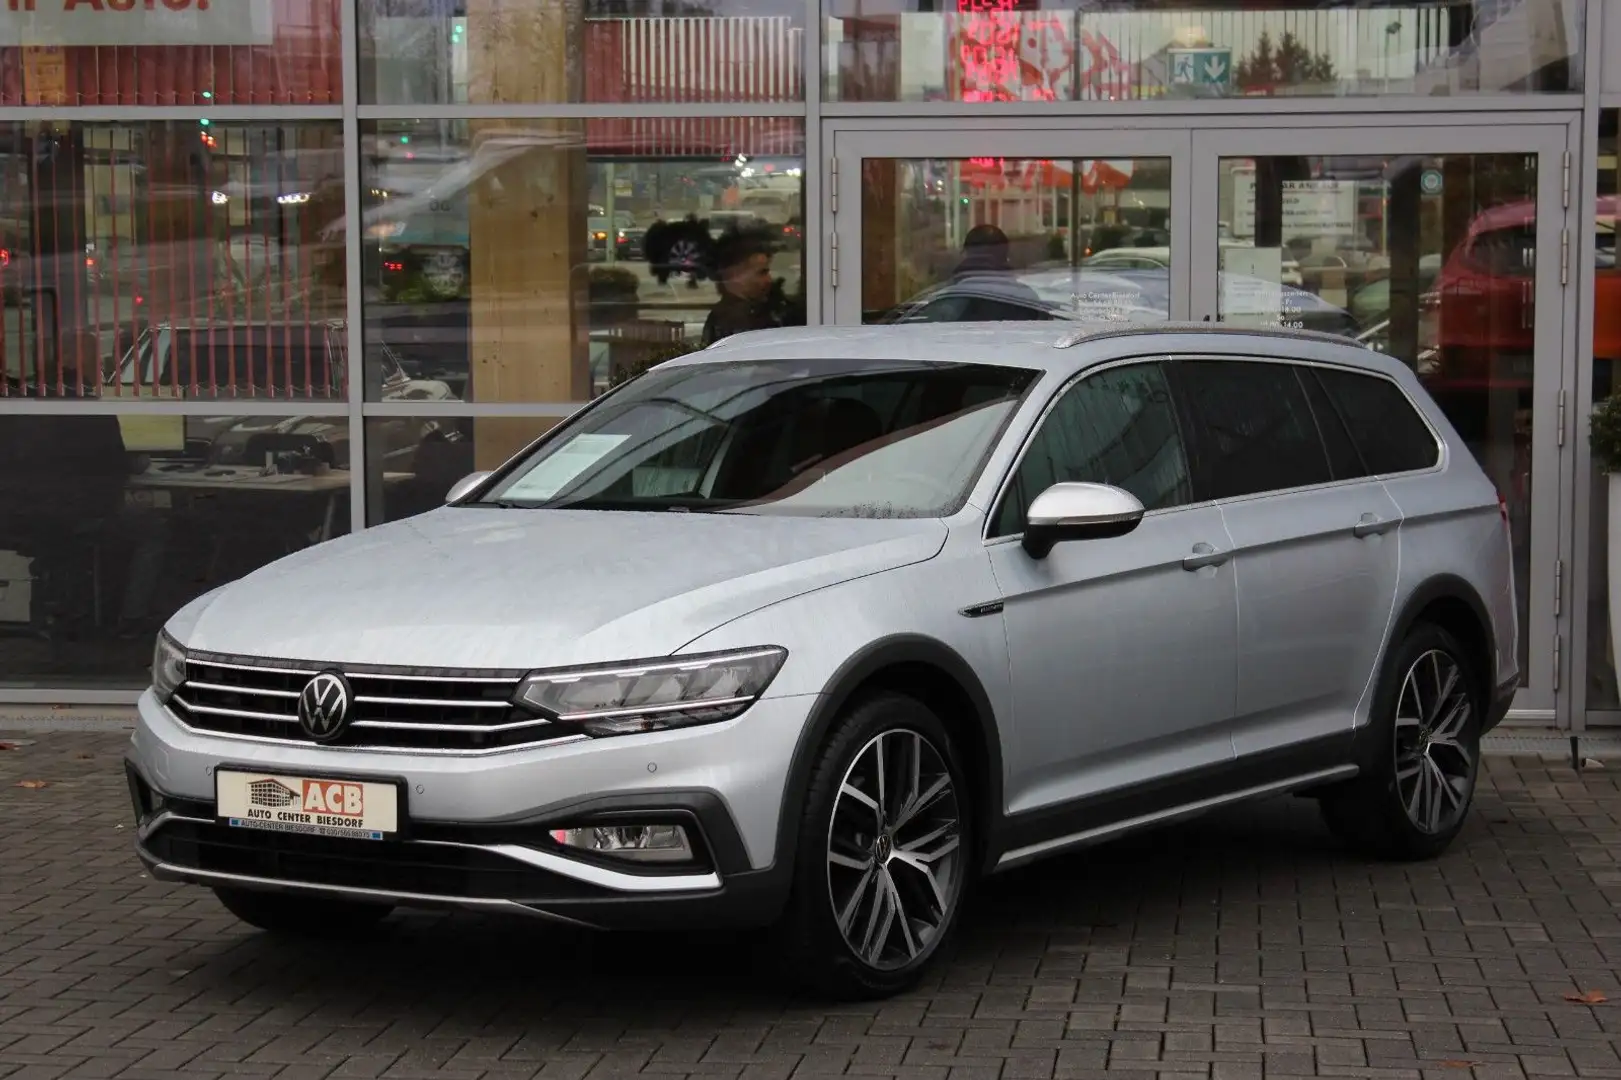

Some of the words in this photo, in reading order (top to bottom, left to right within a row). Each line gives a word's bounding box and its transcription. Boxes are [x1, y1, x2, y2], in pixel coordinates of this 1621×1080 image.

[303, 782, 364, 815] ACB
[248, 808, 272, 820] AUTO
[277, 811, 311, 824] CENTER
[316, 815, 364, 828] BIESDORF
